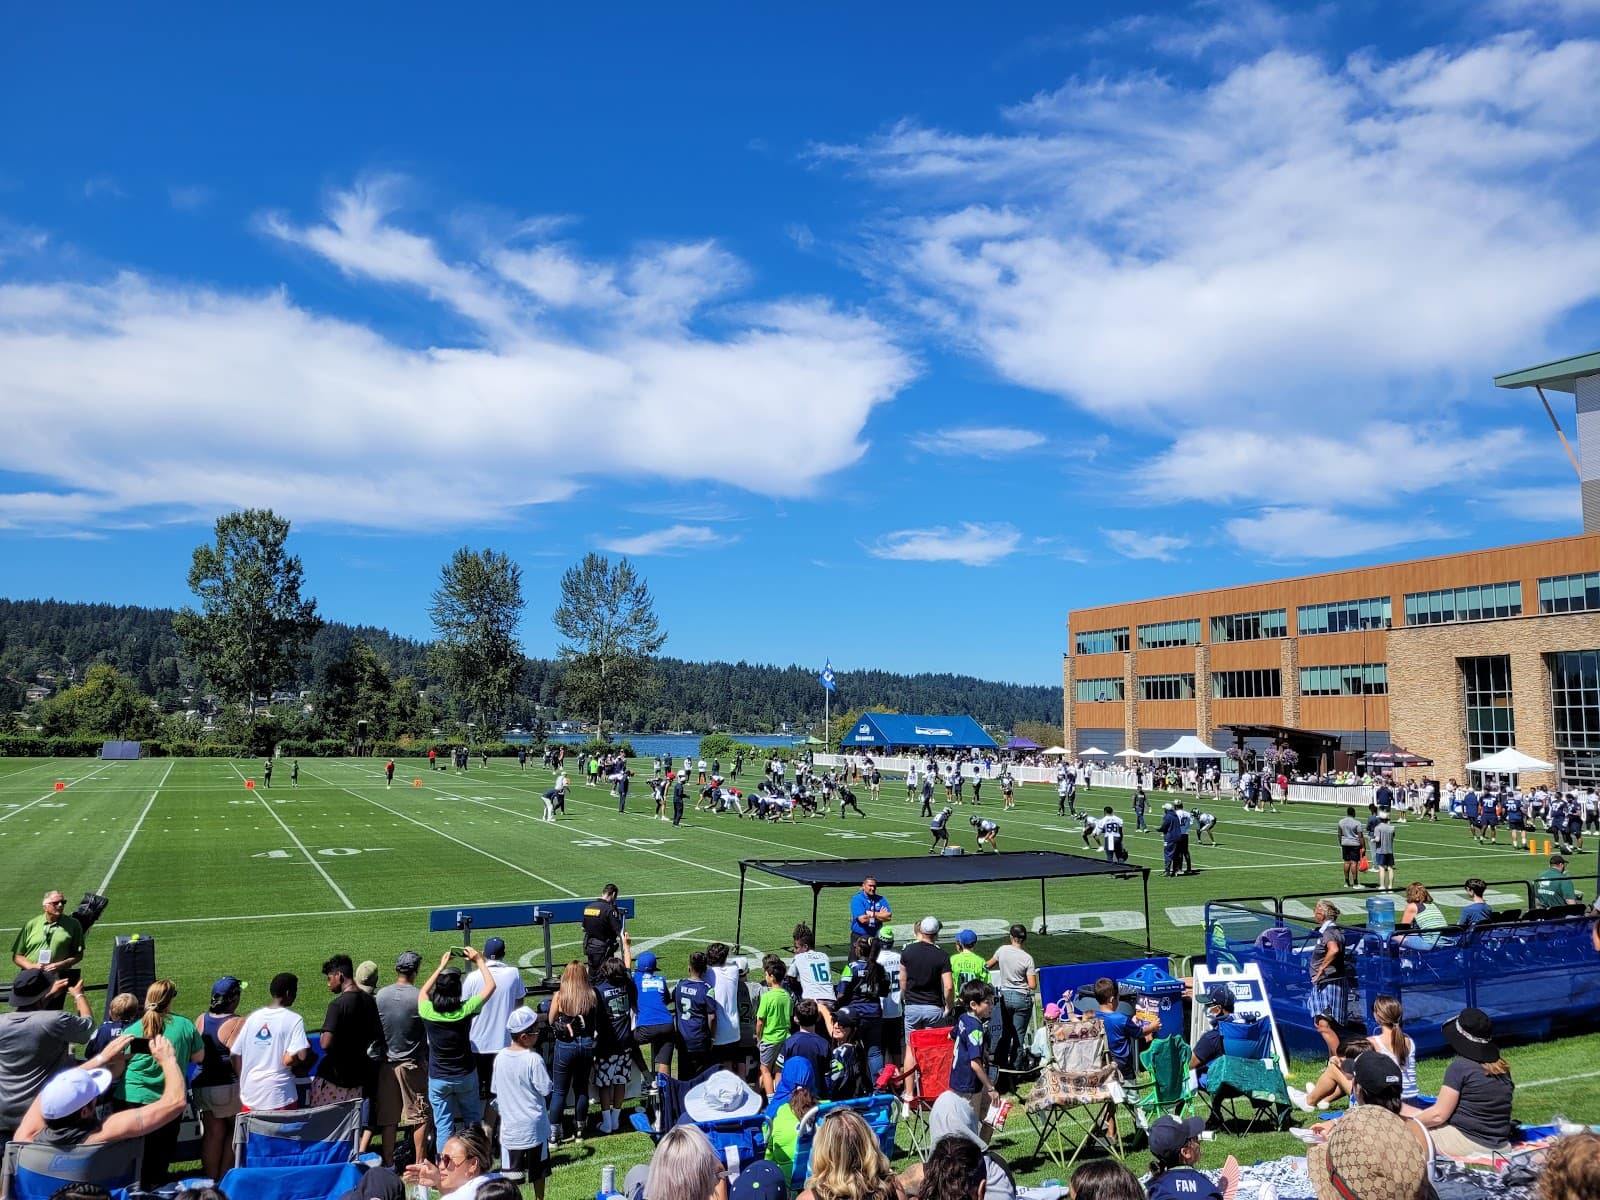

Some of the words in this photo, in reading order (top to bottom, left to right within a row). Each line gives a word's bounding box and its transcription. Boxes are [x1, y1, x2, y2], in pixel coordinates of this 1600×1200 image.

[810, 962, 830, 982] 16
[681, 998, 691, 1020] 3
[1175, 1179, 1197, 1193] FAN
